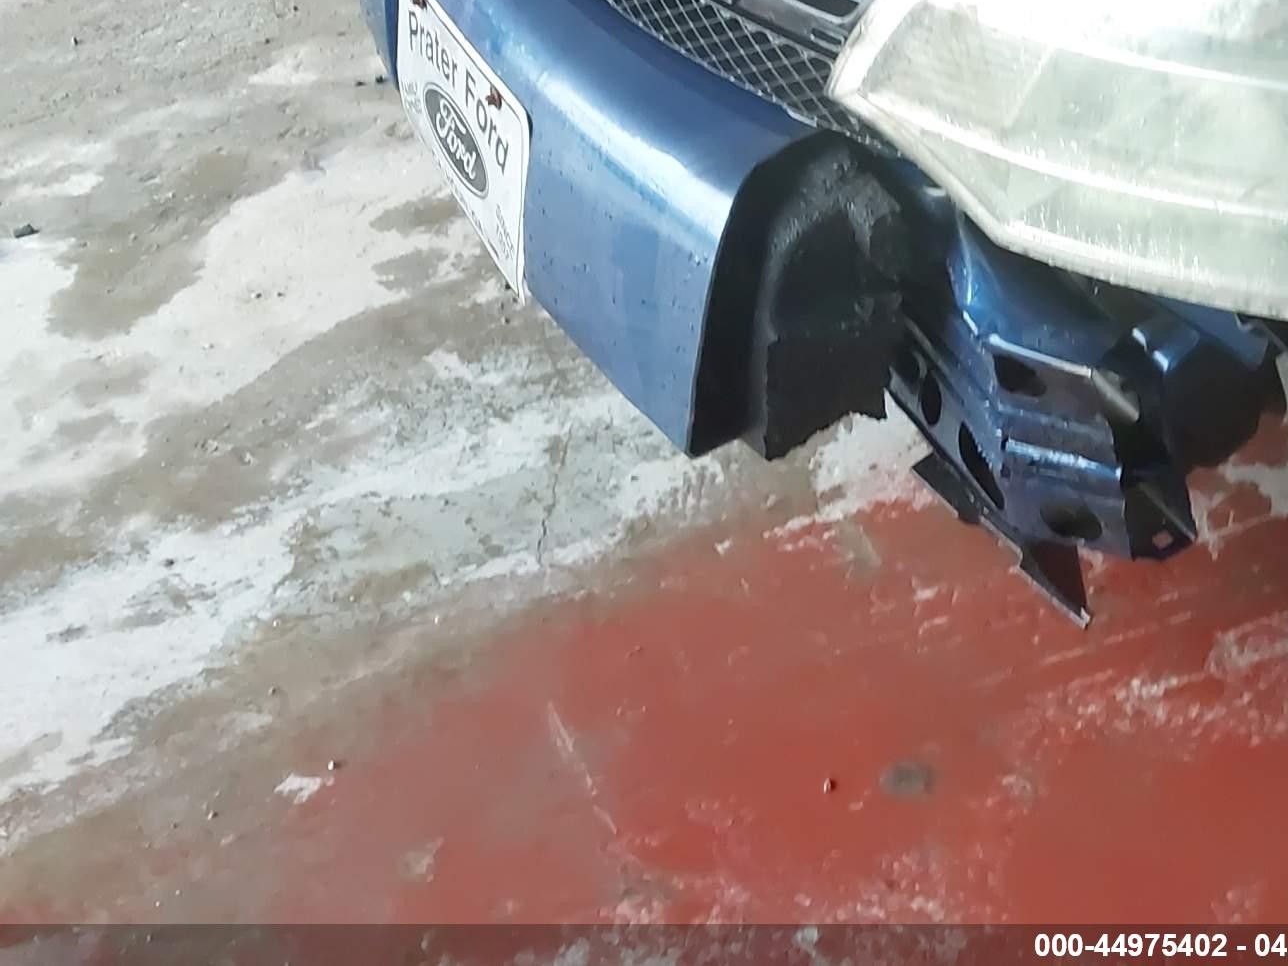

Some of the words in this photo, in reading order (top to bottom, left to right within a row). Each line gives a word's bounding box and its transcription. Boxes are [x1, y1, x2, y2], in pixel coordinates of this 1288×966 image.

[408, 10, 458, 88] Prater
[465, 68, 509, 176] Ford
[436, 98, 477, 180] Ford
